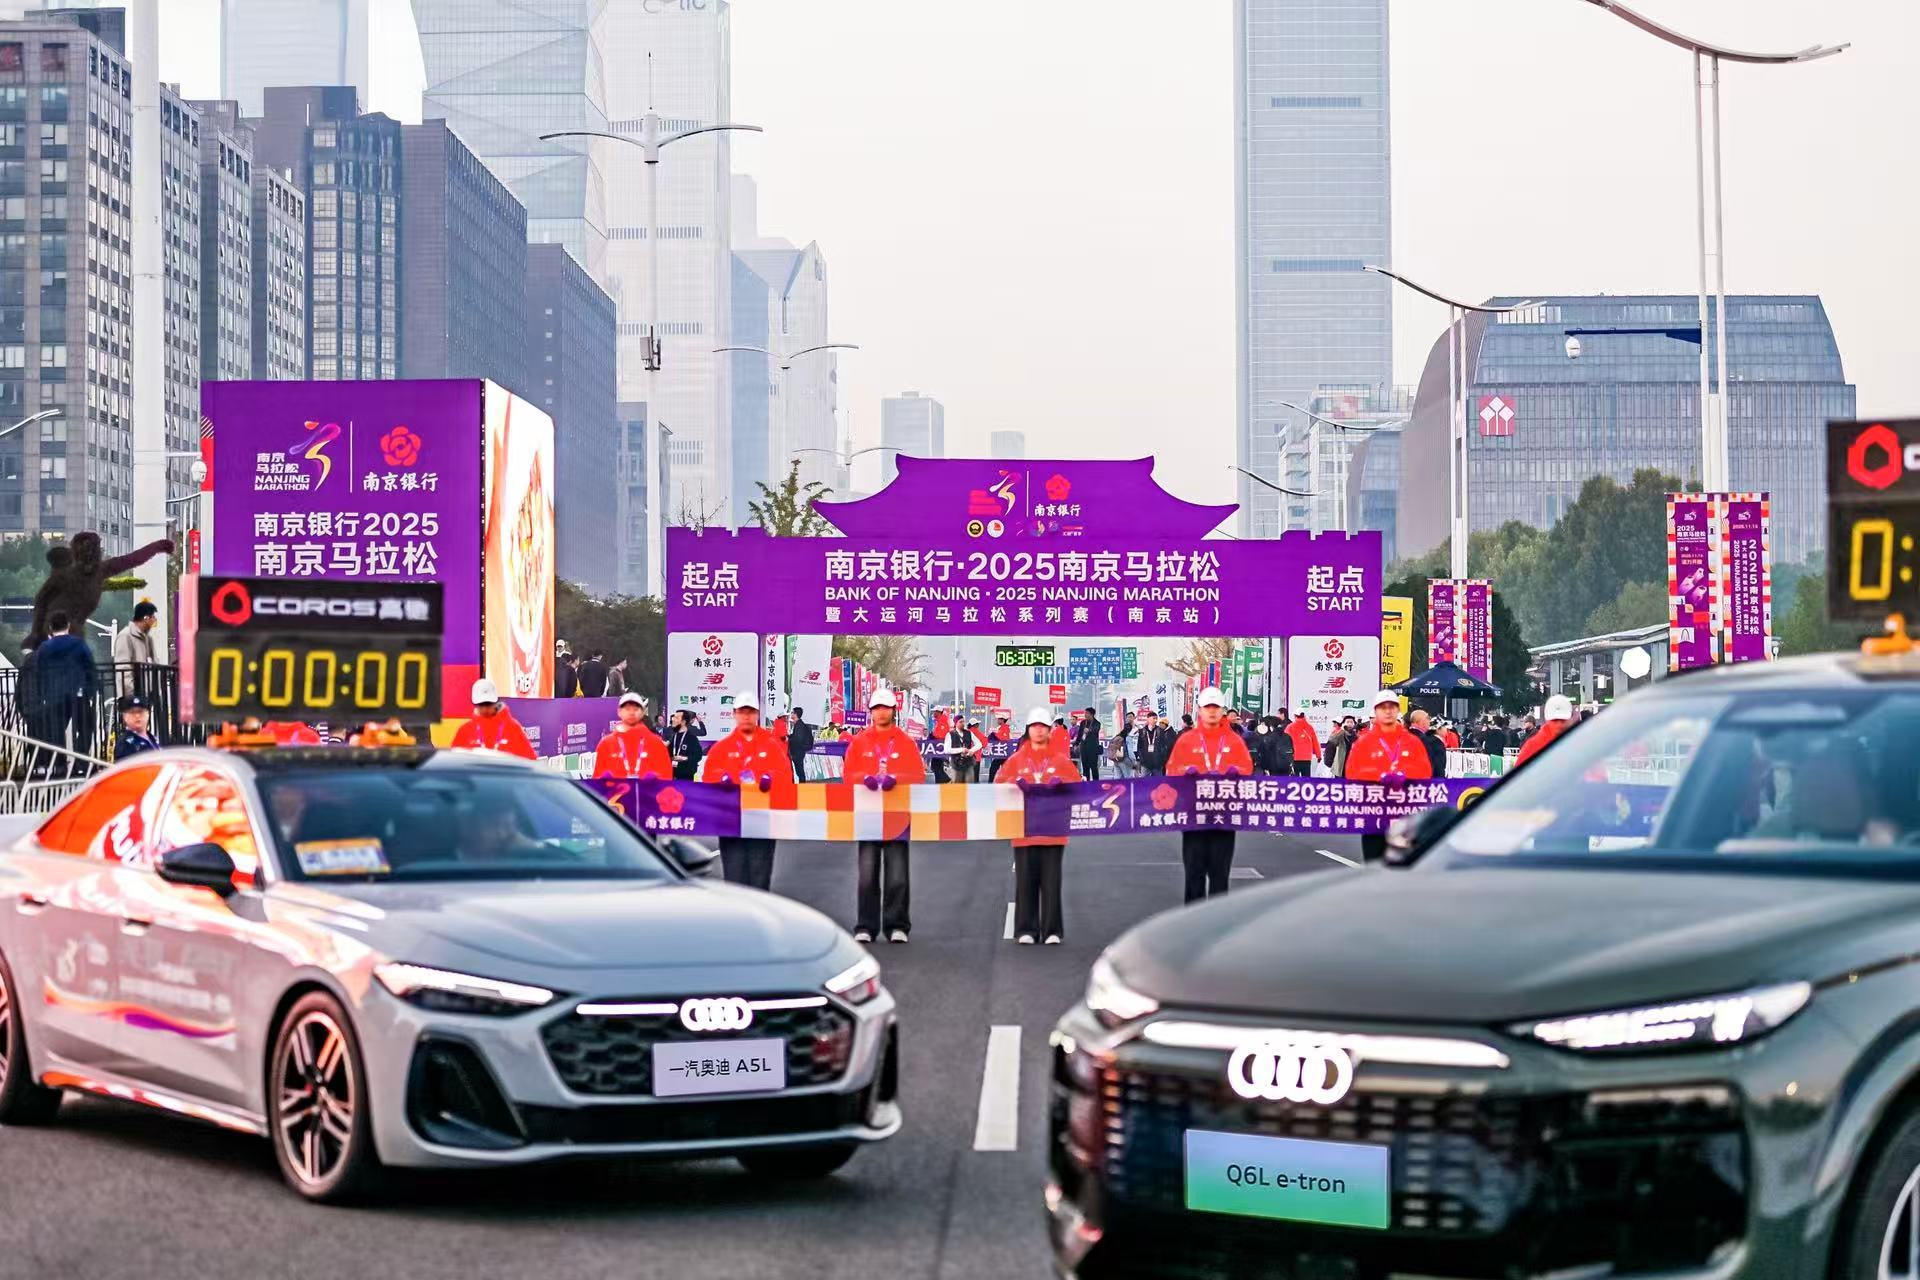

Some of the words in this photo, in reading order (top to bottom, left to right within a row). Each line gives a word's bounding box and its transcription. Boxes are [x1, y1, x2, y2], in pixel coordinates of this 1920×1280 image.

[256, 452, 286, 463] 南京
[256, 463, 300, 474] 马拉松
[255, 474, 310, 484] NANJING
[363, 471, 439, 492] 南京银行
[1034, 503, 1081, 517] 南京银行
[254, 511, 439, 537] 南京银行2025
[254, 541, 439, 576] 南京马拉松
[825, 549, 1221, 583] 南京银行·2025南京马拉松
[682, 562, 740, 590] 起点
[1306, 565, 1365, 594] 起点
[1734, 559, 1742, 592] NANJING
[682, 592, 738, 607] START
[825, 587, 871, 601] BANK
[876, 587, 900, 601] OF
[905, 587, 981, 601] NANJING
[995, 587, 1037, 601] 2025
[1042, 587, 1118, 601] NANJING
[1123, 587, 1220, 601] MARATHON
[1307, 596, 1364, 611] START
[693, 657, 732, 668] 南京银行
[997, 650, 1054, 666] 06:30:43
[1314, 661, 1353, 671] 南京银行
[208, 648, 428, 708] 0:00:00
[767, 649, 776, 706] 南京银行
[1195, 802, 1225, 811] BANK
[1229, 802, 1243, 812] OF
[1247, 803, 1296, 814] NANJING
[1304, 805, 1331, 815] 2025
[1335, 806, 1383, 815] NANJING
[1140, 812, 1188, 827] 南京银行
[669, 1058, 731, 1078] 一汽奥迪
[735, 1058, 772, 1074] A5L
[1227, 1164, 1270, 1187] Q6L
[1276, 1173, 1346, 1194] e-tron
